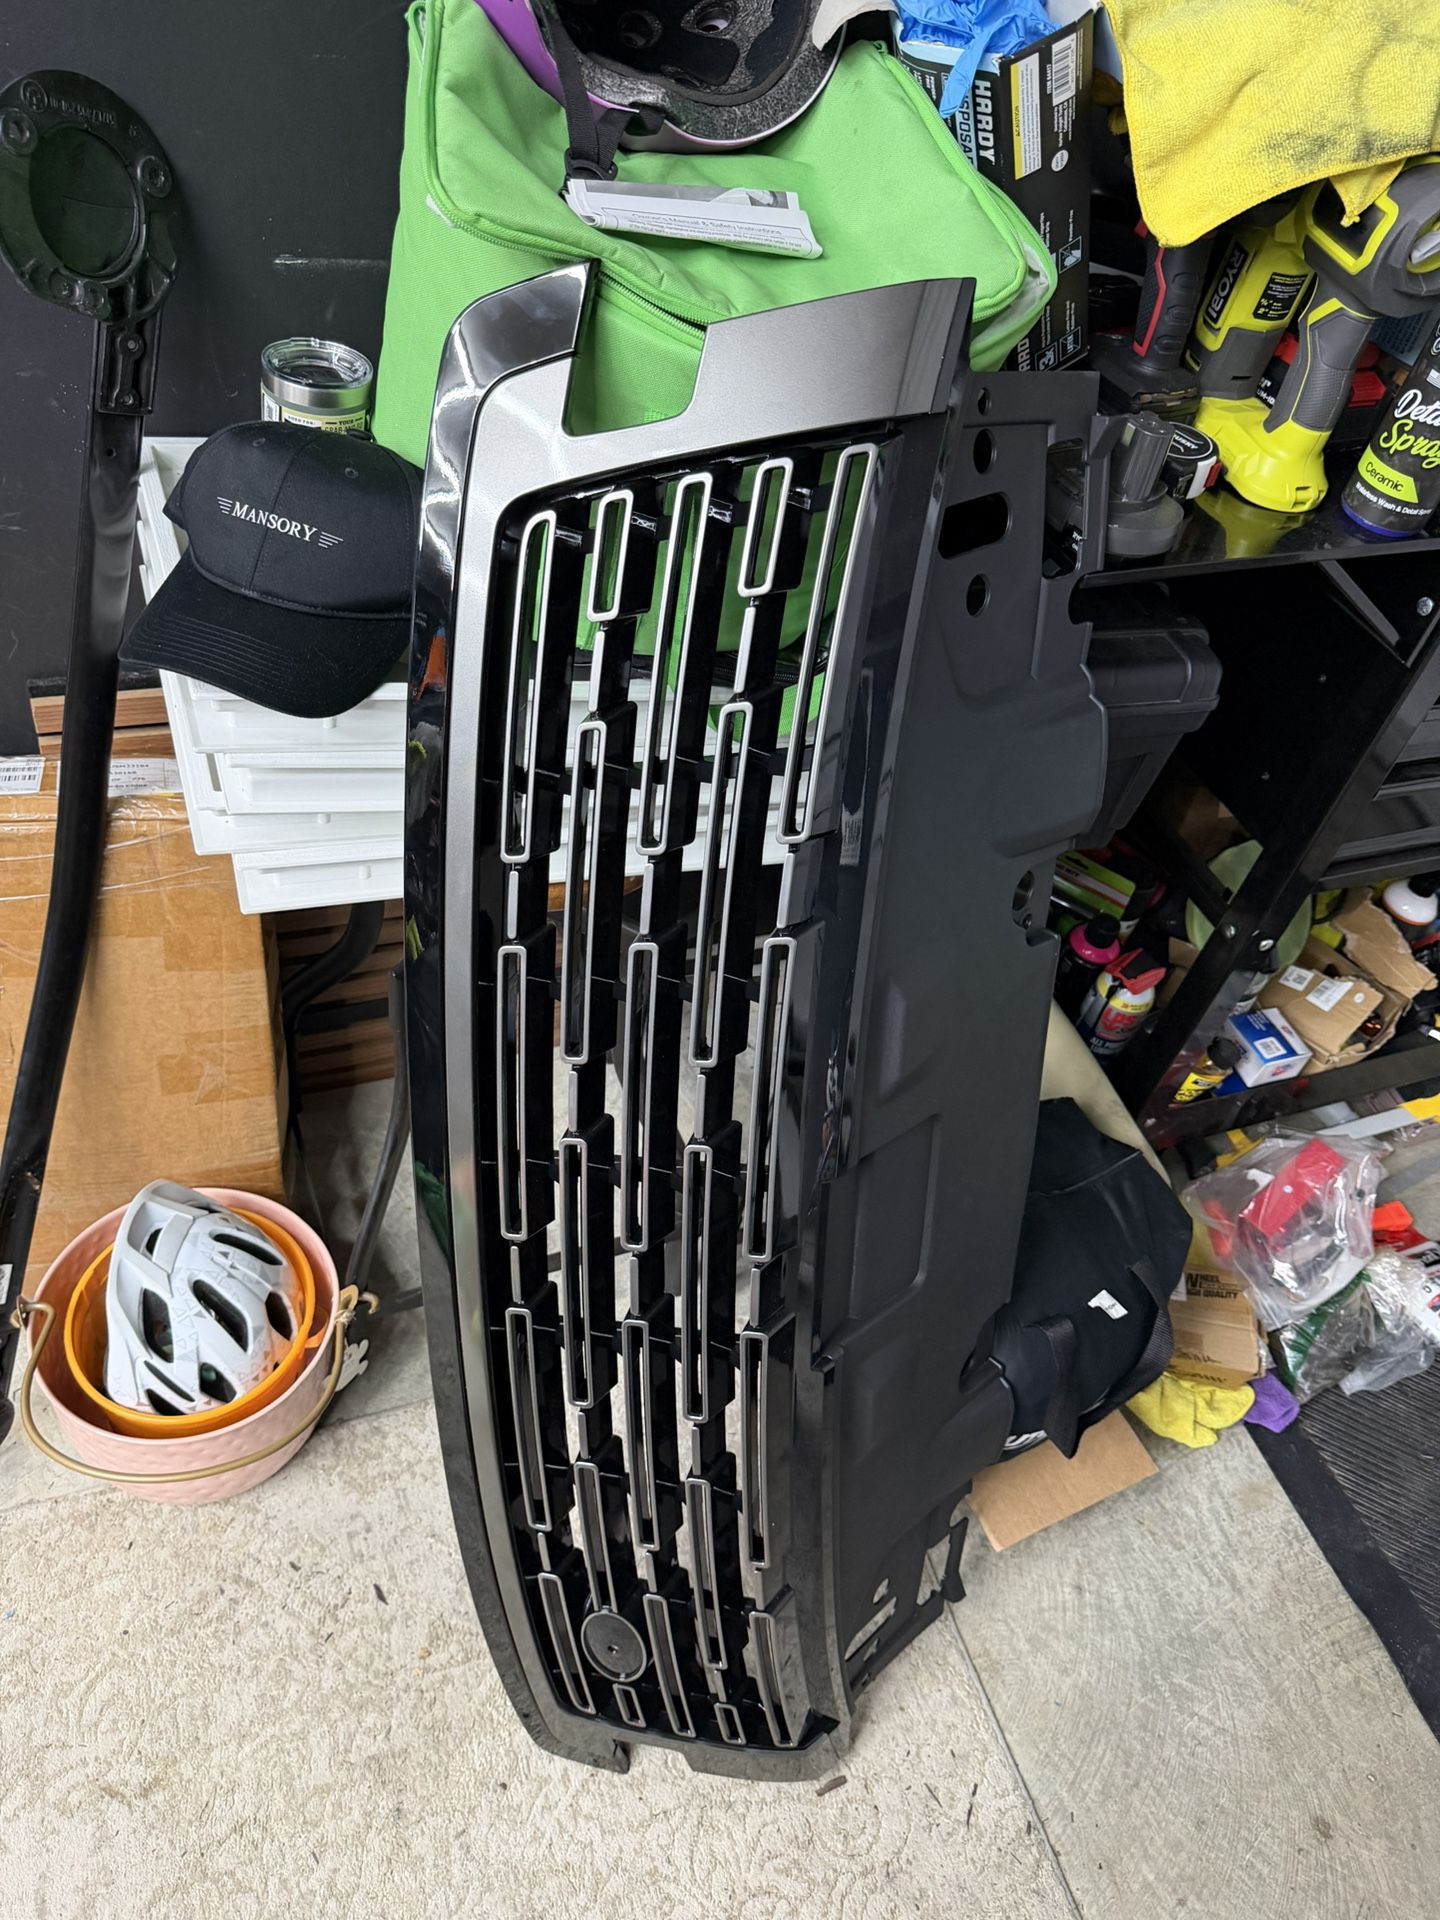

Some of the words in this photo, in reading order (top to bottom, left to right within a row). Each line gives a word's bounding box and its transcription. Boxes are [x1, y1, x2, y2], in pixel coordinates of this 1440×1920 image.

[975, 80, 995, 163] HARDY
[1207, 249, 1245, 319] RYOBI
[1018, 338, 1031, 372] ARD
[1394, 389, 1440, 427] Deta
[1365, 461, 1404, 492] Ceramic
[231, 501, 318, 542] MANSORY
[1377, 497, 1396, 511] Wash
[1402, 507, 1419, 515] Detail
[1203, 1289, 1238, 1299] QUALITY
